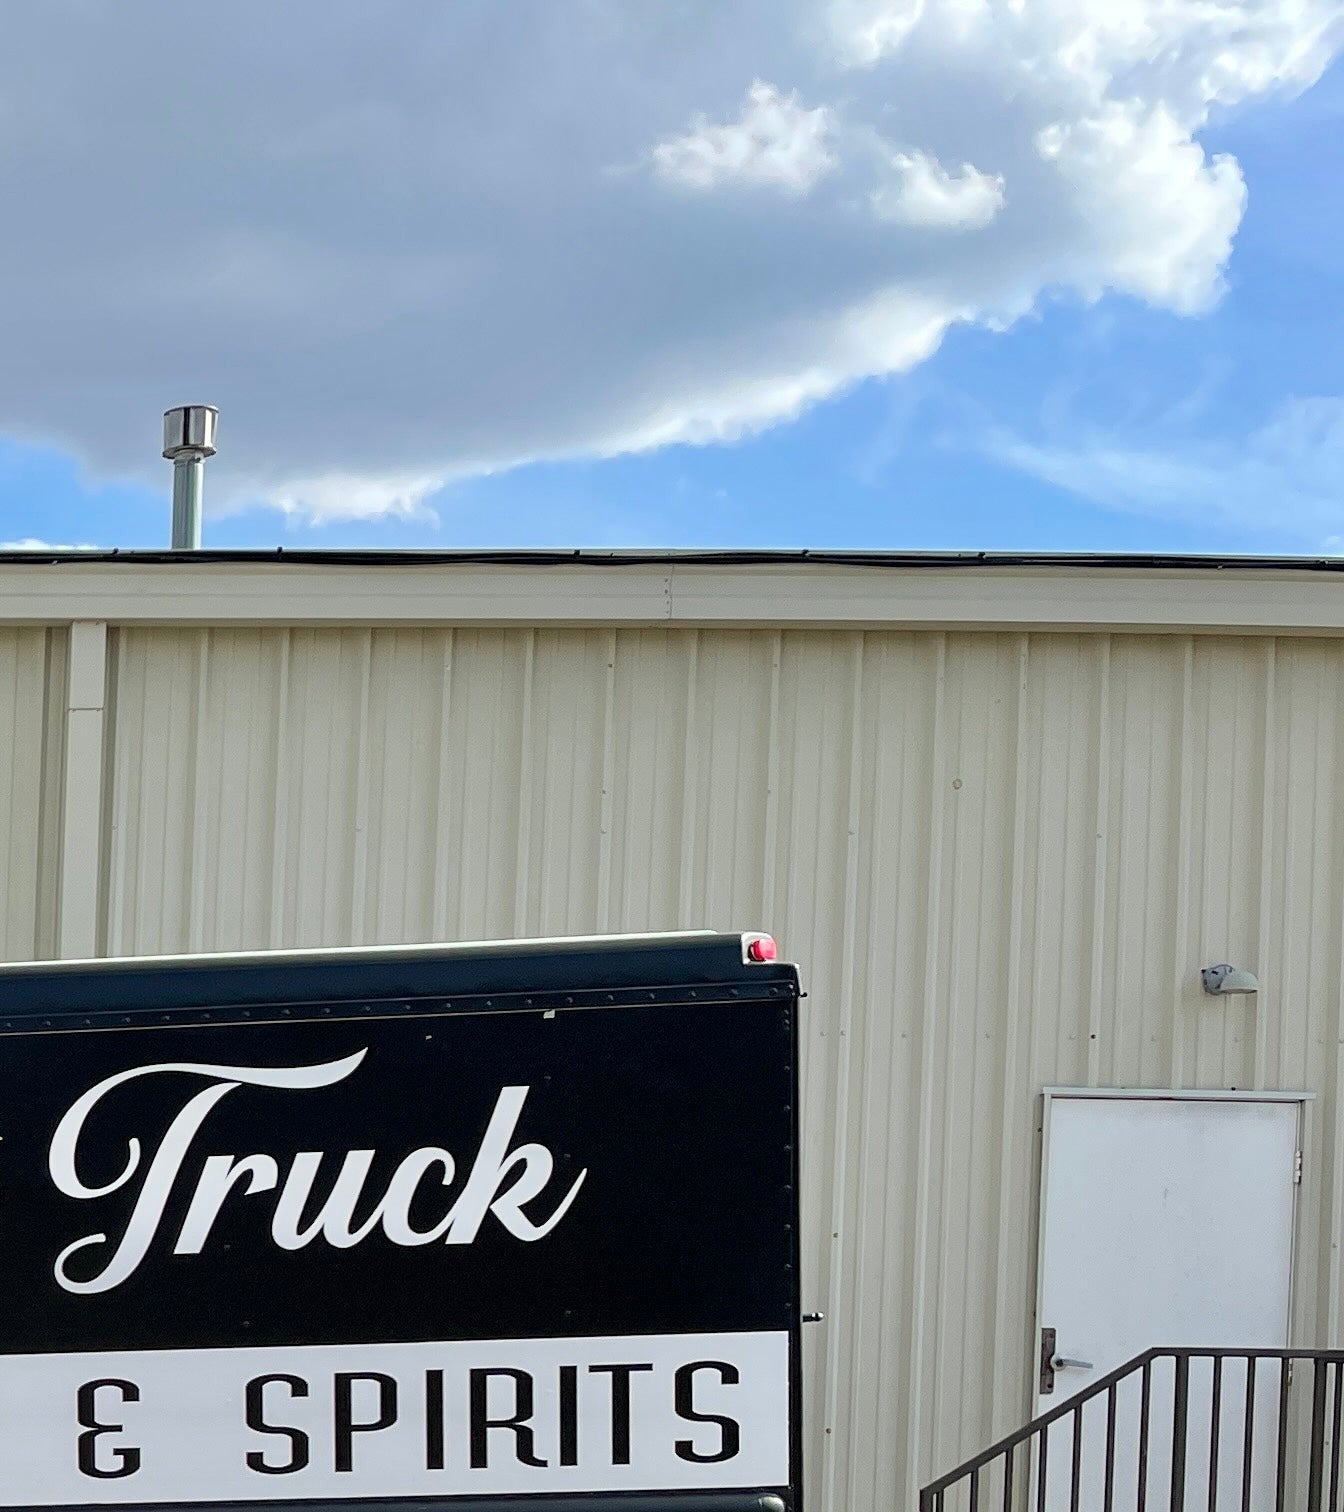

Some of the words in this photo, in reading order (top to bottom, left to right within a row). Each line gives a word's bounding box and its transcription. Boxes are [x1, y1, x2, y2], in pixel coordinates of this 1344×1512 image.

[48, 1046, 588, 1296] Truck
[77, 1378, 141, 1479] &
[245, 1360, 740, 1475] SPIRITS
